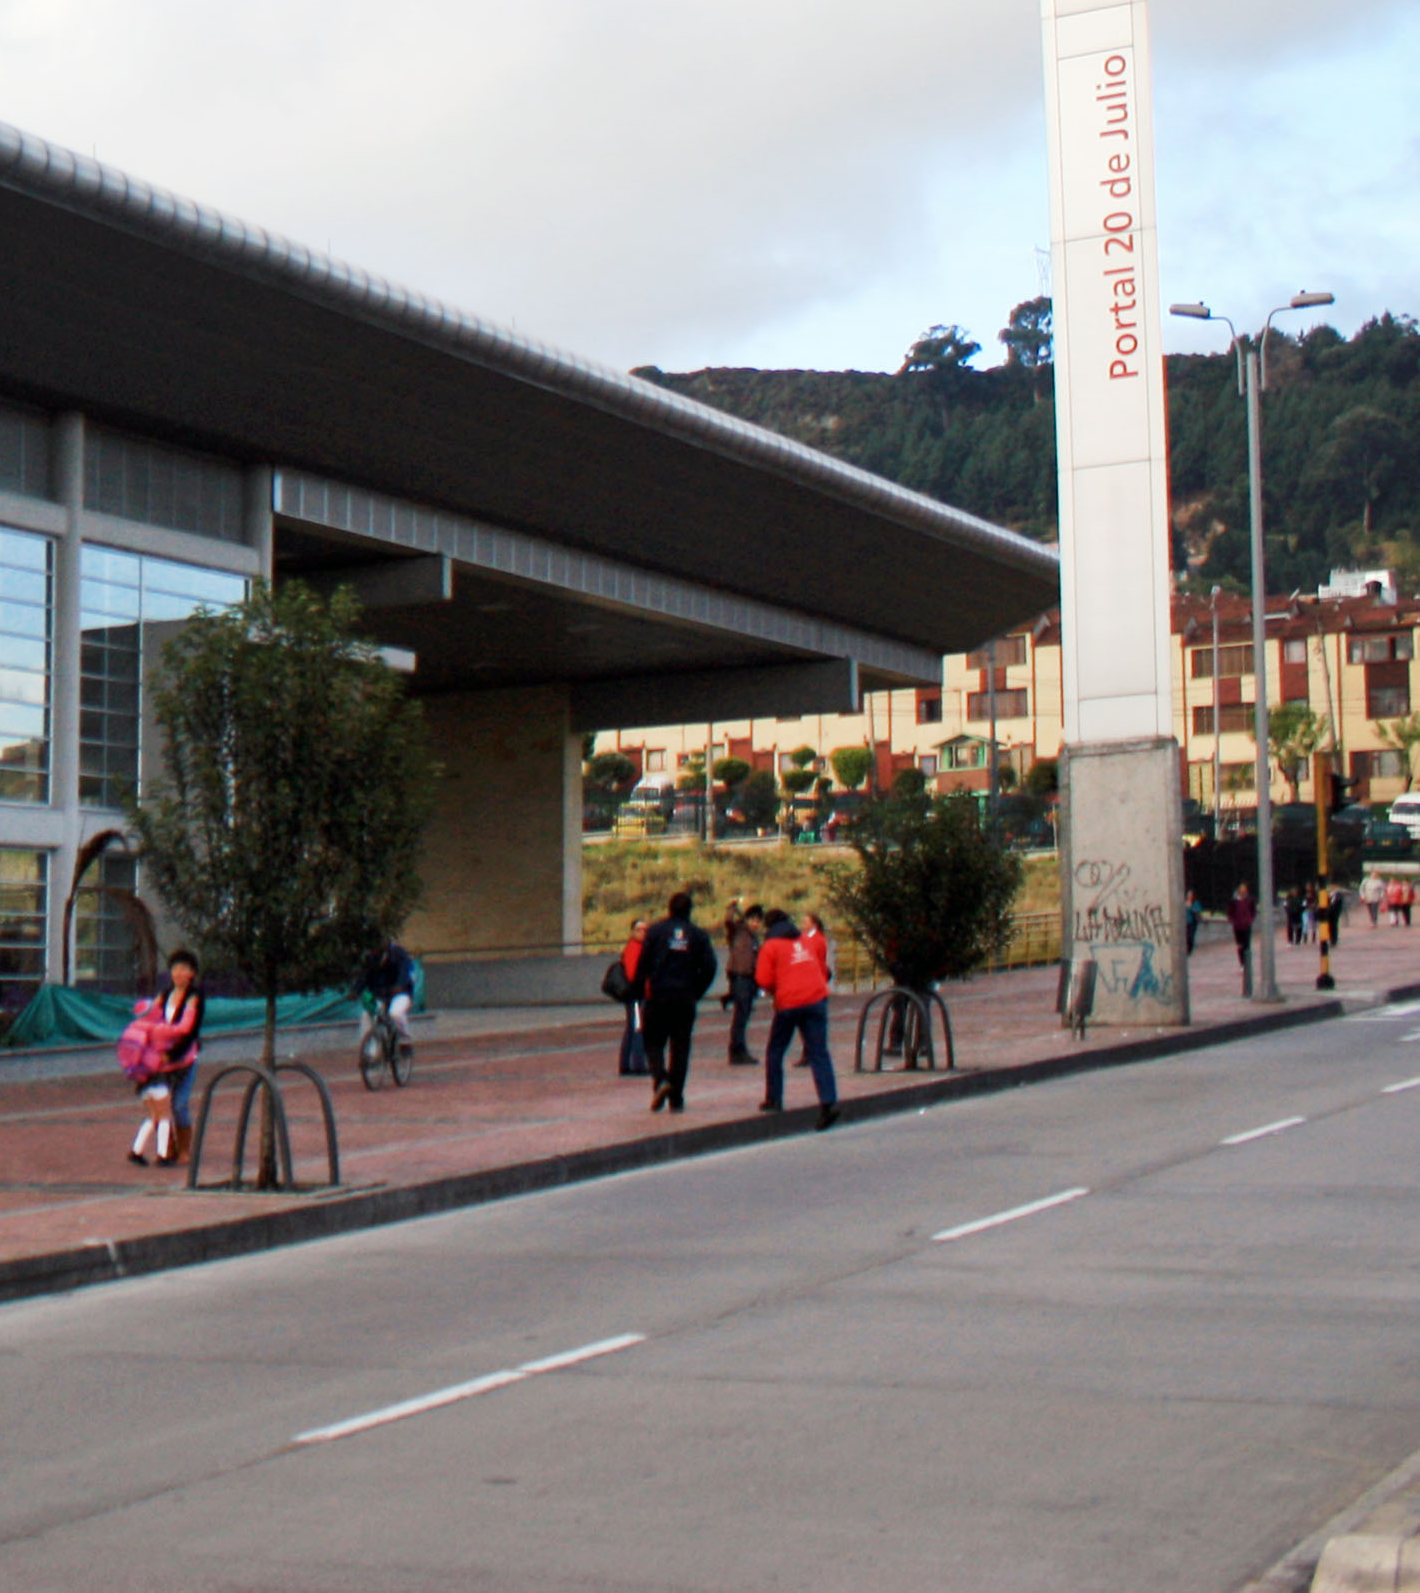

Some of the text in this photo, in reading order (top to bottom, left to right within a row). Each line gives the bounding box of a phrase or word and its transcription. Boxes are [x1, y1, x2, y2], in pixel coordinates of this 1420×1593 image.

[1096, 55, 1139, 380] Portal 20 de Julio
